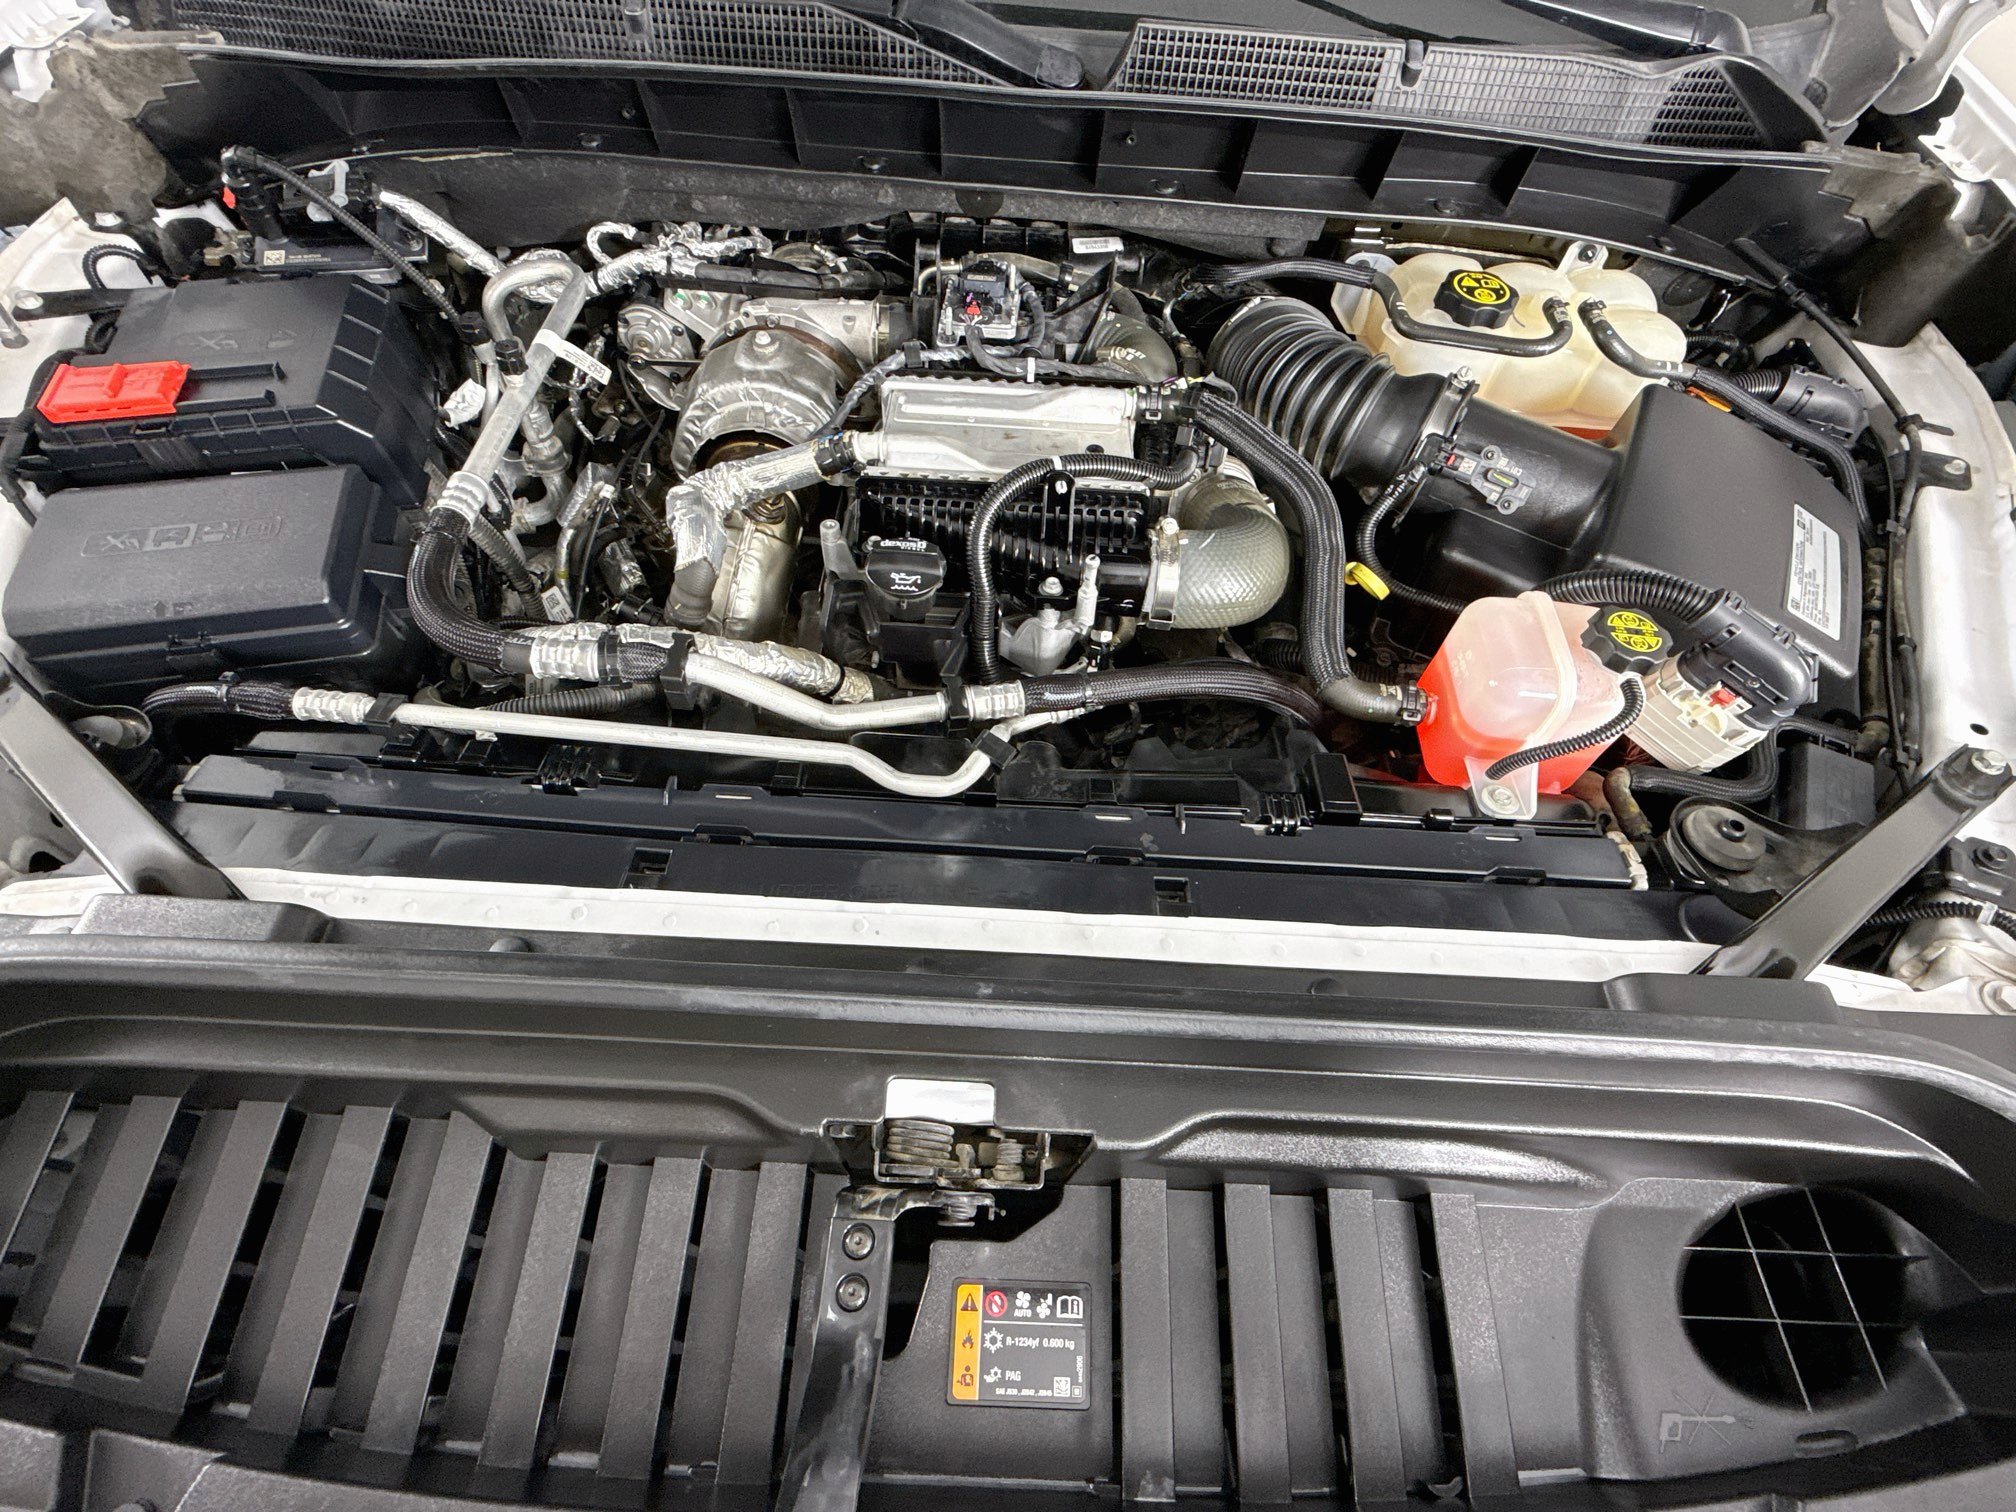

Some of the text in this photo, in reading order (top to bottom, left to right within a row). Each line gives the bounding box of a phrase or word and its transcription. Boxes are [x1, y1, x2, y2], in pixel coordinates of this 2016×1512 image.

[1013, 1308, 1032, 1318] AUTO
[1005, 1336, 1075, 1351] R-1234yf 0.600 kg
[1005, 1370, 1022, 1381] PAG
[995, 1387, 1005, 1395] SAE
